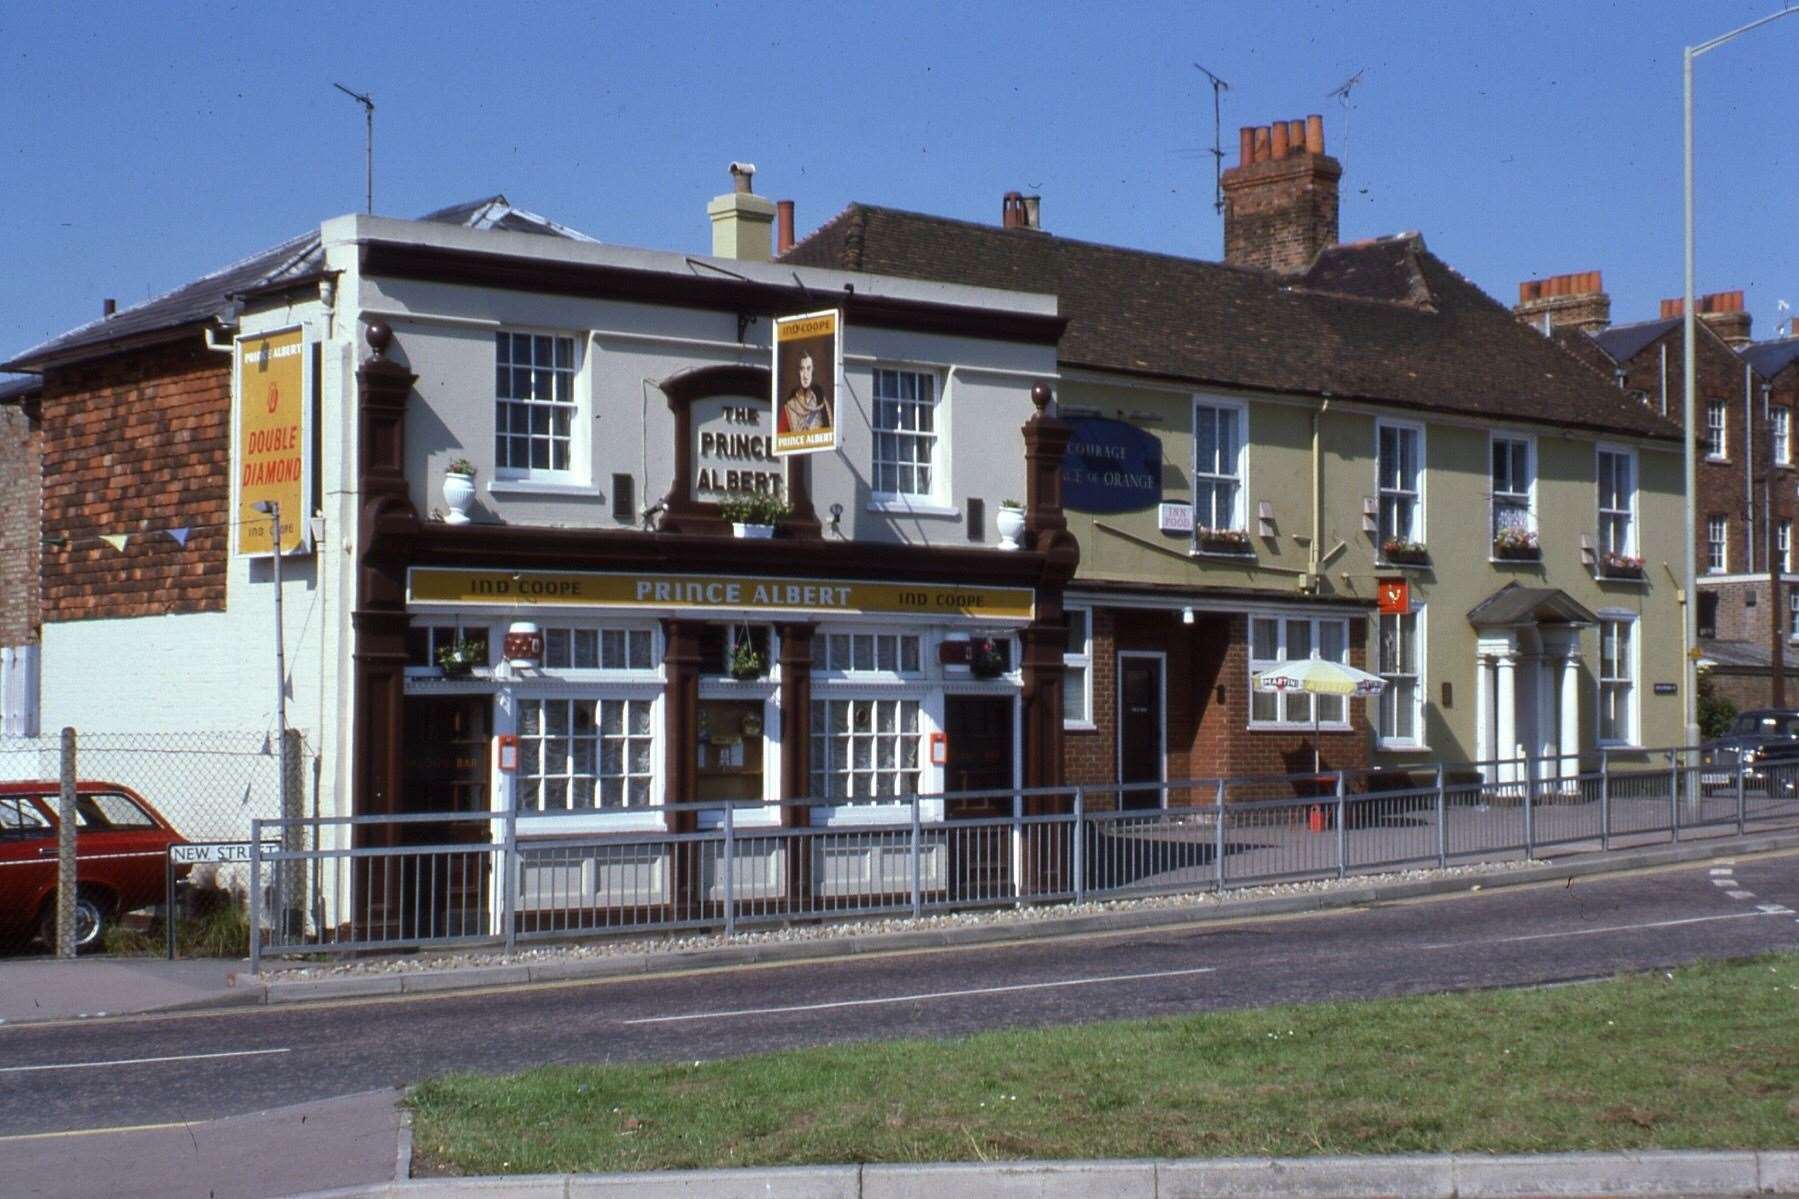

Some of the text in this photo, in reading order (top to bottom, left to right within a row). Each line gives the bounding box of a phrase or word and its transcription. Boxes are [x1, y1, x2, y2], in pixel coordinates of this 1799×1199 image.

[721, 406, 760, 426] THE
[248, 426, 297, 455] DOUBLE
[778, 431, 833, 448] PRINCE ALBERT
[243, 457, 302, 487] DIAMOND
[1103, 471, 1153, 489] ORANGE
[697, 468, 783, 497] ALBERT
[518, 580, 581, 595] COOPE
[636, 581, 851, 607] PRINCE ALBERT
[936, 593, 984, 608] COOPE
[1263, 677, 1299, 688] MARTINI
[174, 847, 210, 860] NEW
